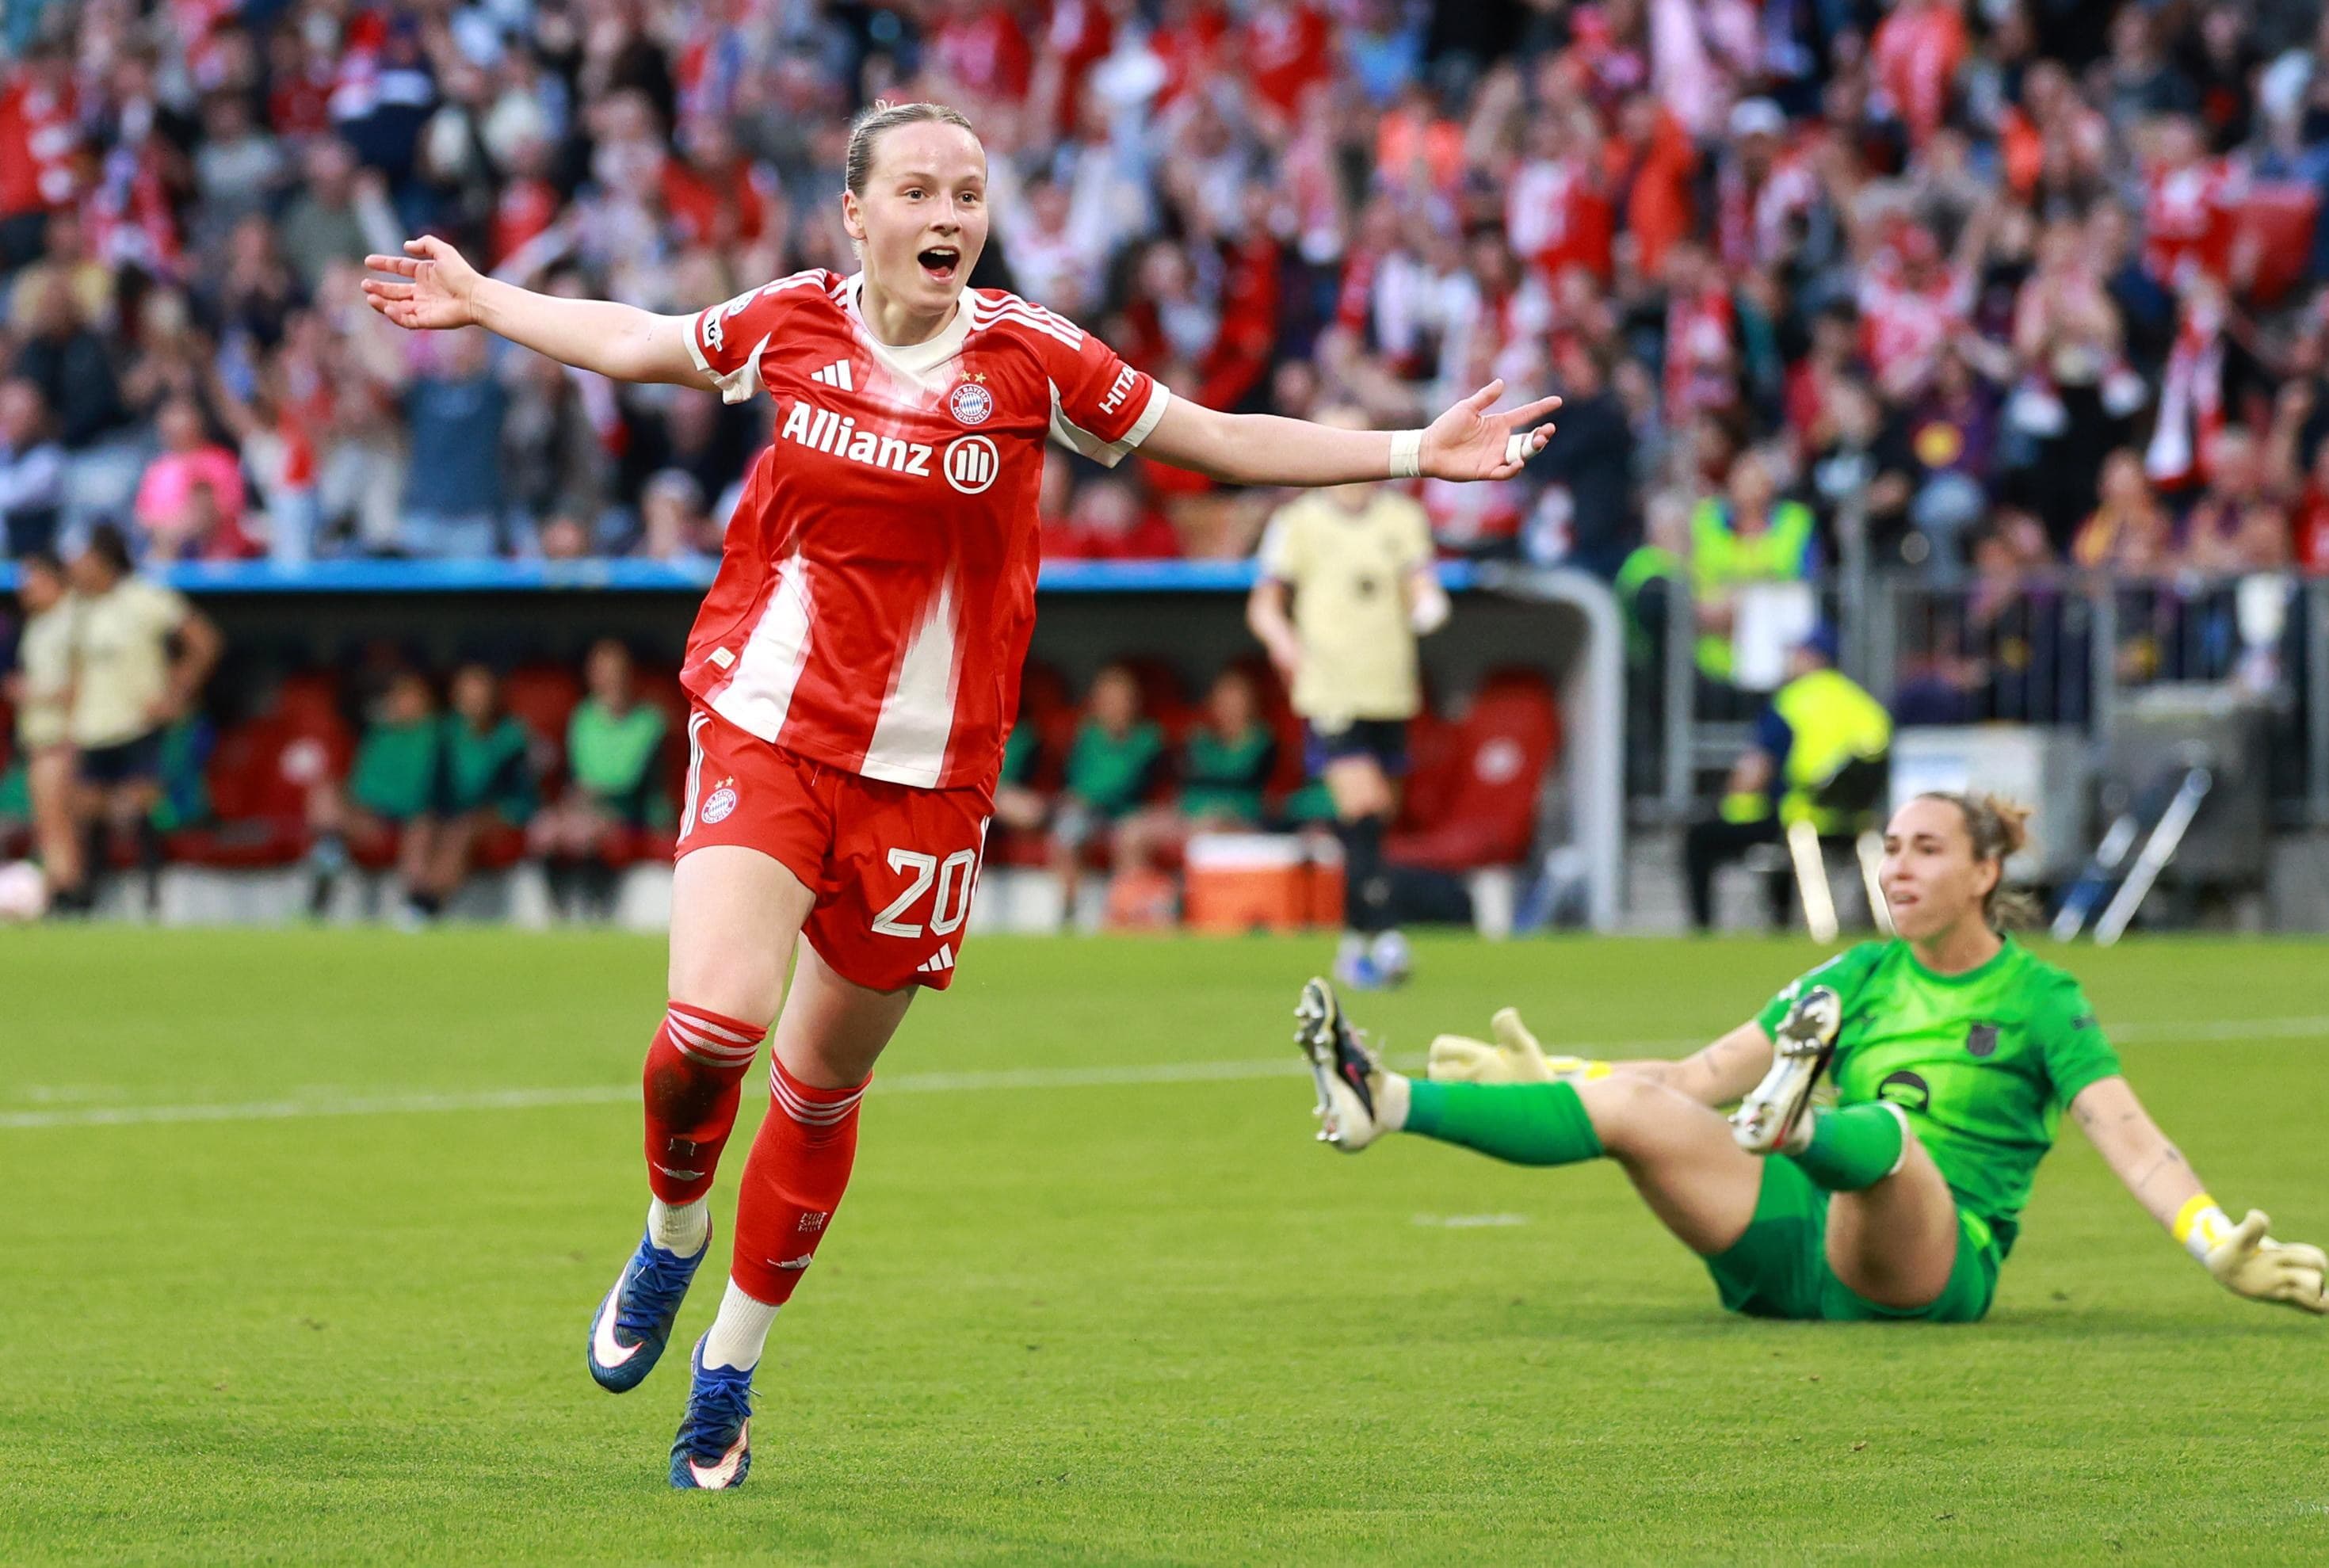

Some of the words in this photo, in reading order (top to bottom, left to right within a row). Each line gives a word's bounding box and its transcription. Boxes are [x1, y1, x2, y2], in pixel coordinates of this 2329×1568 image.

[953, 390, 964, 401] FC
[962, 386, 990, 403] BAYERN
[1098, 366, 1138, 415] HITA
[781, 400, 934, 477] Allianz
[870, 847, 976, 939] 20
